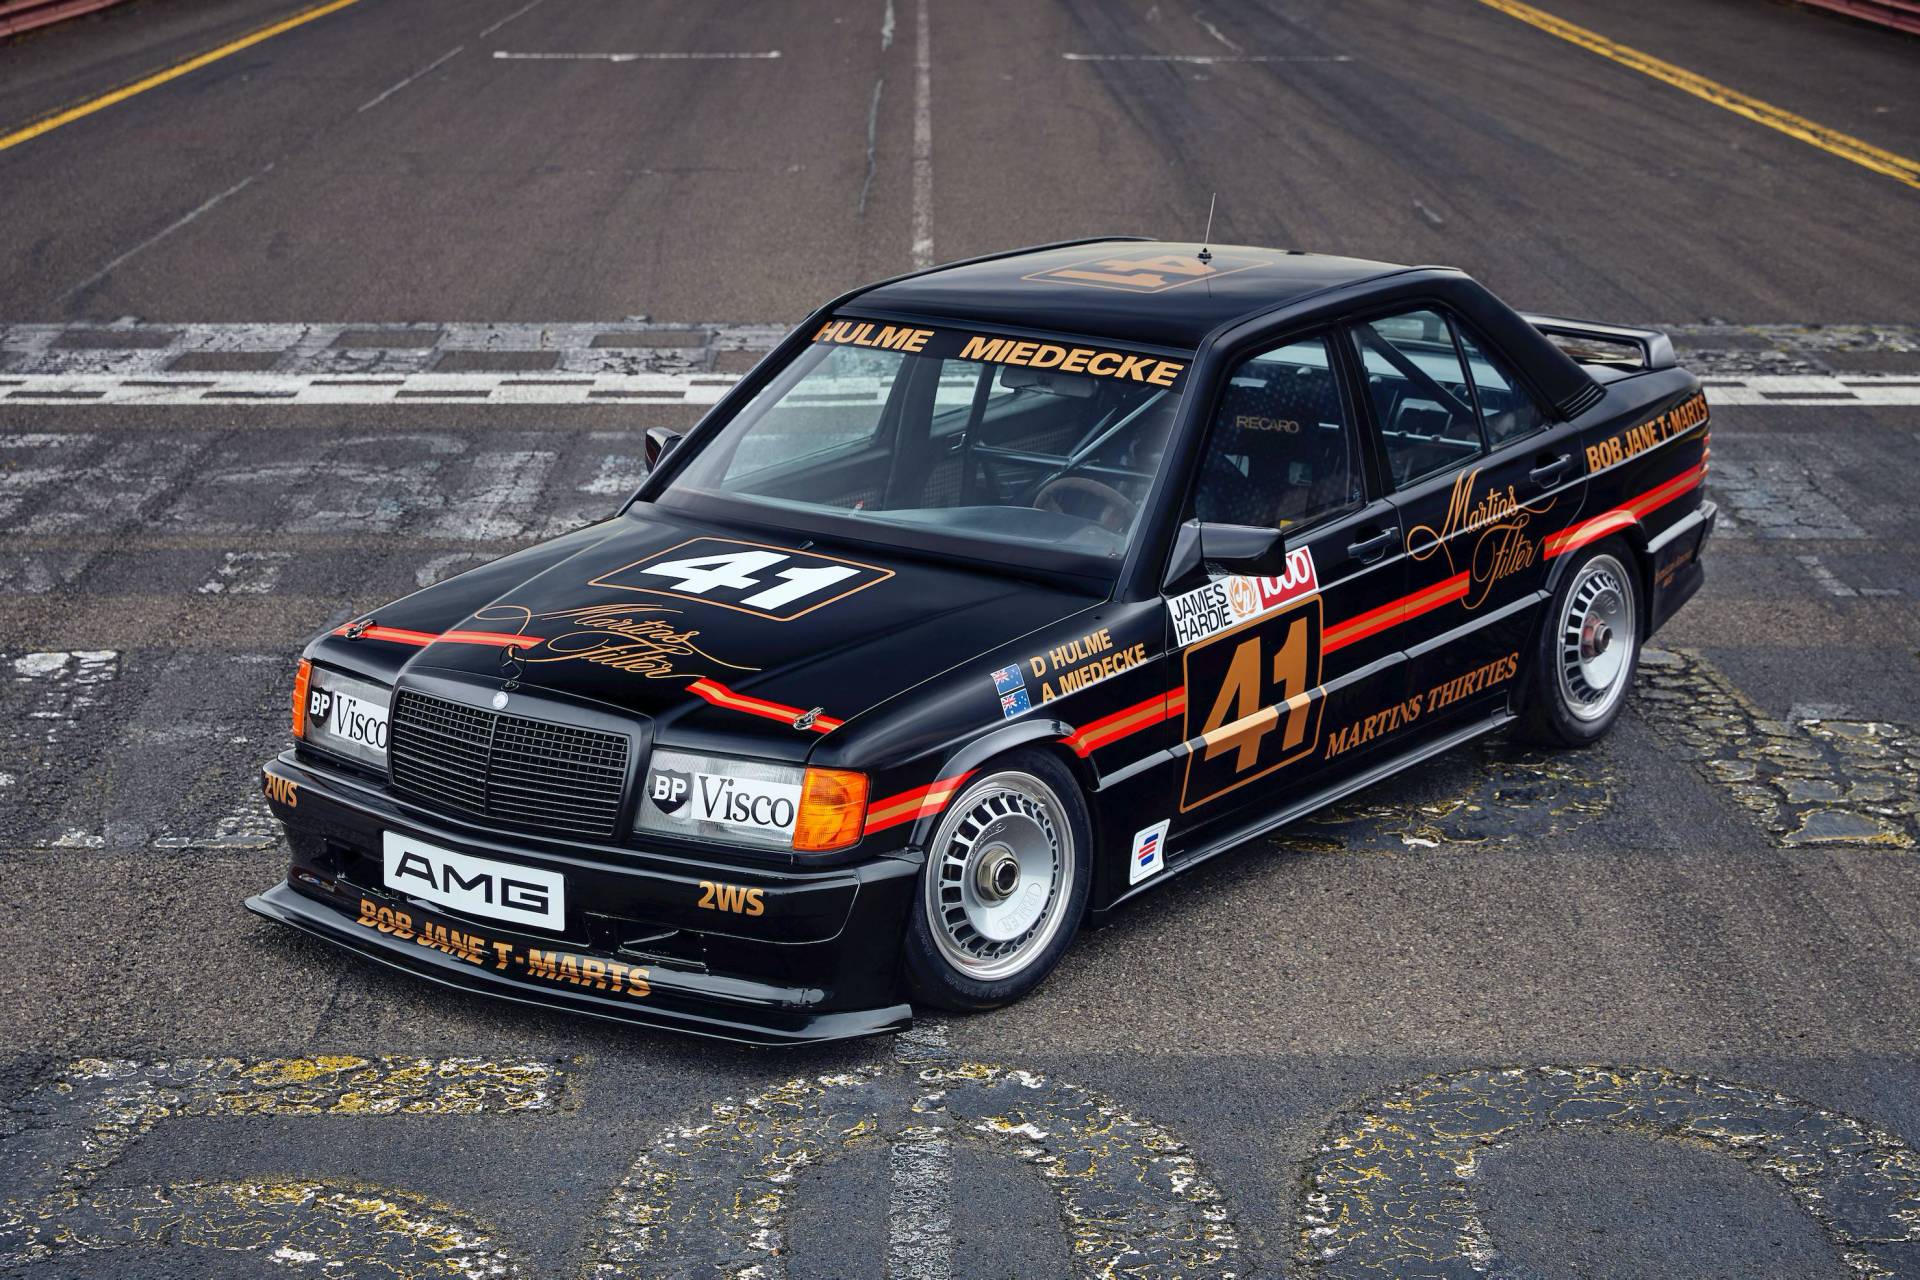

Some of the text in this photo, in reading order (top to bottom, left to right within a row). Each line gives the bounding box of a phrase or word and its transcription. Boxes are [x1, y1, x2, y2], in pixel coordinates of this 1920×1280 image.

[1049, 255, 1217, 287] 41
[811, 321, 1184, 387] HULME MIEDECKE
[1236, 415, 1300, 434] RECARO
[1585, 436, 1625, 474] BOB
[1623, 420, 1660, 458] JANE
[640, 550, 861, 610] 41
[1461, 513, 1545, 609] Filter
[1174, 583, 1228, 622] JAMES
[1176, 603, 1233, 645] HARDIE
[1030, 628, 1114, 678] D HULME
[1042, 643, 1149, 704] A MIEDECKE
[310, 691, 389, 749] BP Visco
[1201, 620, 1311, 774] 41
[1324, 652, 1519, 760] MARTINS THIRTIES
[264, 774, 299, 808] 2WS
[652, 774, 795, 828] BP Visco
[395, 851, 549, 915] AMG
[698, 880, 765, 917] 2WS
[356, 898, 414, 939] BOB
[416, 922, 486, 965] JANE
